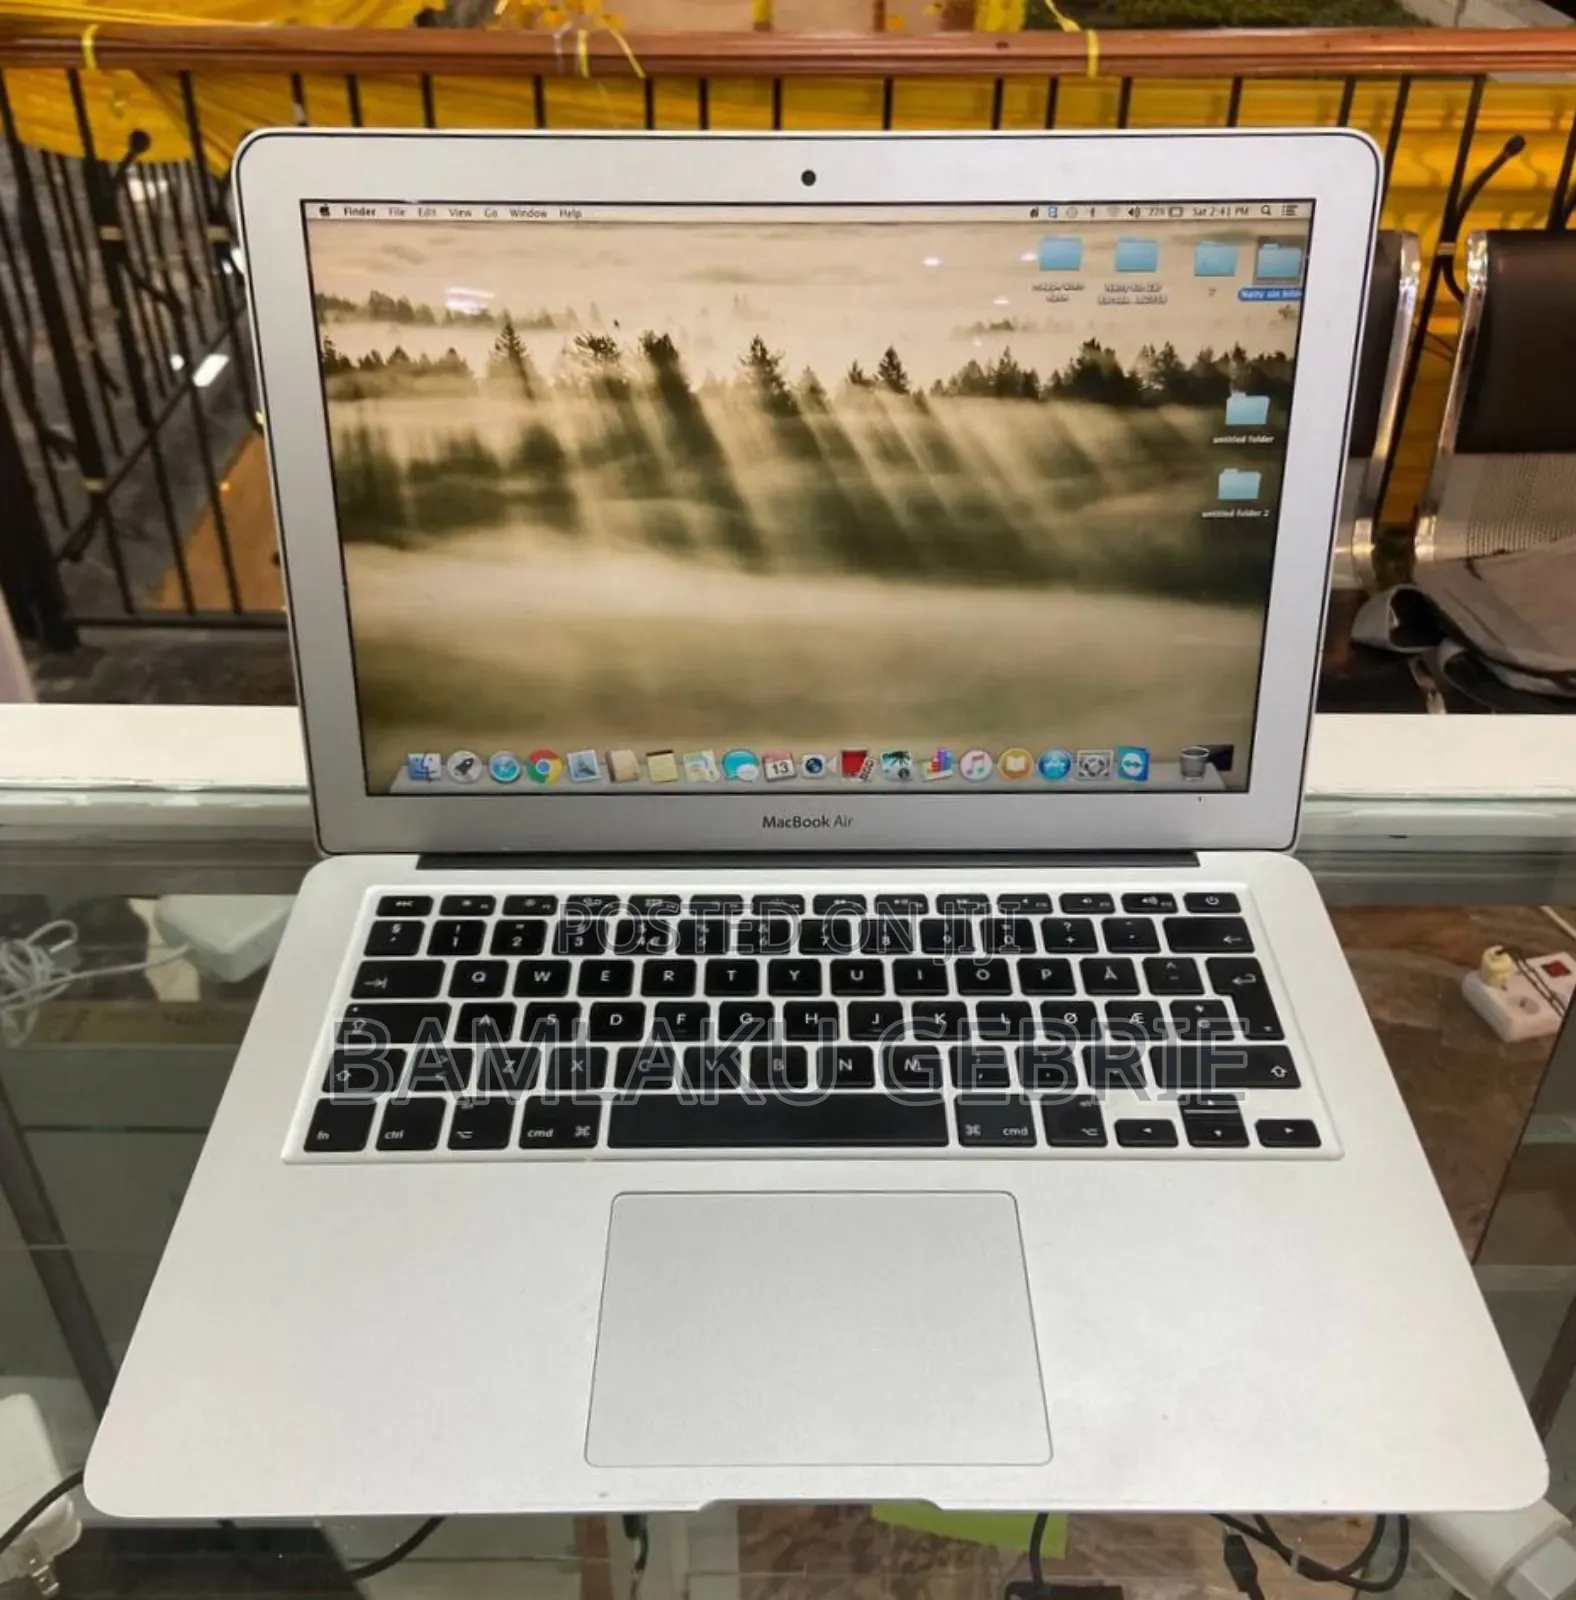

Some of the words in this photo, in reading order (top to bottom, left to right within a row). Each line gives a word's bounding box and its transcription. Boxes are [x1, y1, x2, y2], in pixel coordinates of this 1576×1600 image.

[343, 206, 376, 217] Finder
[388, 207, 405, 217] File
[418, 207, 437, 217] Edit
[448, 208, 473, 218] View
[484, 208, 498, 218] Go
[509, 208, 548, 218] Window
[559, 208, 583, 220] Help
[1191, 206, 1207, 217] Sat
[1209, 206, 1231, 217] 2:41
[1234, 206, 1250, 217] PM
[1212, 434, 1247, 444] untitled
[1248, 434, 1275, 444] folder
[1202, 508, 1235, 518] untitled
[1236, 508, 1262, 518] folder
[772, 761, 790, 775] 13
[762, 814, 831, 829] MacBook
[832, 813, 854, 829] Air
[452, 936, 459, 947] 1
[512, 936, 523, 947] 2
[573, 936, 585, 947] 3
[471, 971, 487, 983] Q
[533, 970, 552, 982] W
[600, 970, 611, 982] E
[663, 970, 676, 982] R
[726, 970, 738, 981] T
[788, 969, 800, 981] Y
[850, 969, 864, 981] U
[976, 969, 990, 981] O
[1041, 968, 1053, 980] P
[1104, 966, 1118, 980] Å
[478, 1014, 492, 1026] A
[547, 1014, 557, 1025] S
[609, 1013, 623, 1026] D
[676, 1013, 687, 1025] F
[739, 1012, 753, 1025] G
[805, 1012, 819, 1025] H
[871, 1012, 880, 1025] J
[934, 1012, 946, 1025] K
[1000, 1012, 1011, 1024] L
[503, 1060, 516, 1074] Z
[570, 1059, 584, 1072] X
[637, 1059, 652, 1072] C
[705, 1059, 718, 1072] V
[773, 1059, 785, 1071] B
[839, 1058, 853, 1071] N
[903, 1059, 921, 1072] M
[316, 1130, 330, 1141] fn
[384, 1130, 404, 1140] ctrl
[527, 1128, 554, 1138] cmd
[1002, 1126, 1029, 1137] cmd
